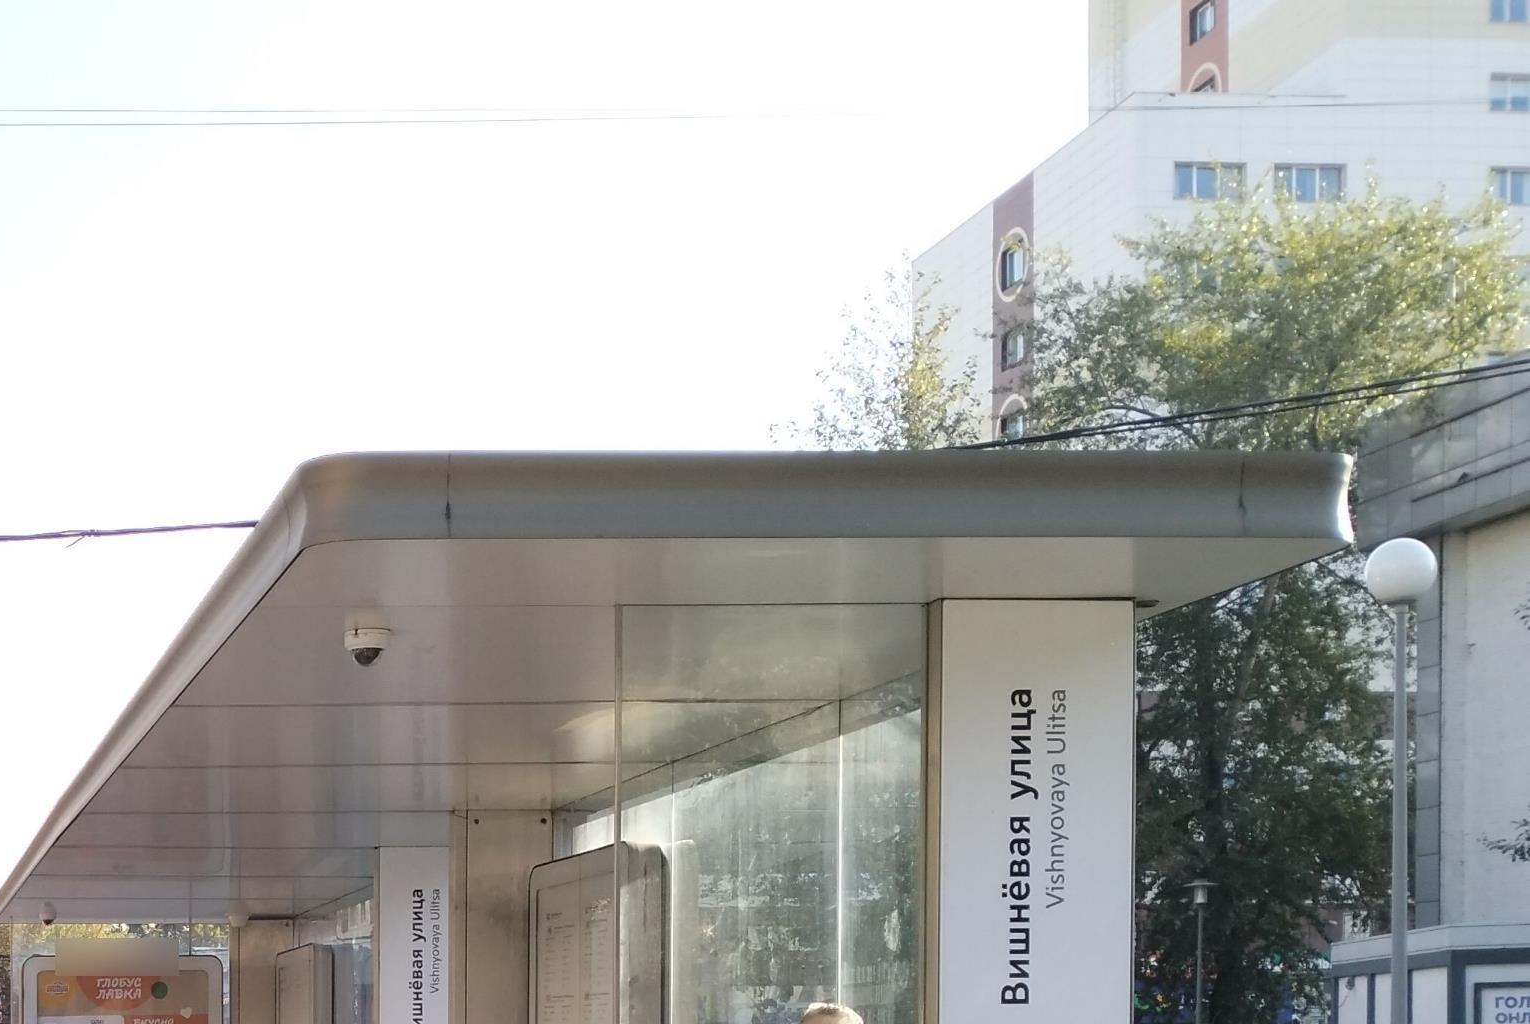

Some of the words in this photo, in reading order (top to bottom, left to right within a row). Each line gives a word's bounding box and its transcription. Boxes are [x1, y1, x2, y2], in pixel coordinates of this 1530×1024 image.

[1009, 688, 1039, 801] улица
[1046, 688, 1068, 754] Ulitsa
[1045, 762, 1070, 909] Vishnyovaya
[412, 888, 427, 943] улица
[429, 888, 441, 920] Ulitsa
[1000, 815, 1031, 1005] Вишнёвая
[96, 977, 142, 988] ГЛОБУС
[429, 924, 443, 994] Vishnyovaya
[95, 988, 142, 1000] ЛАВКА
